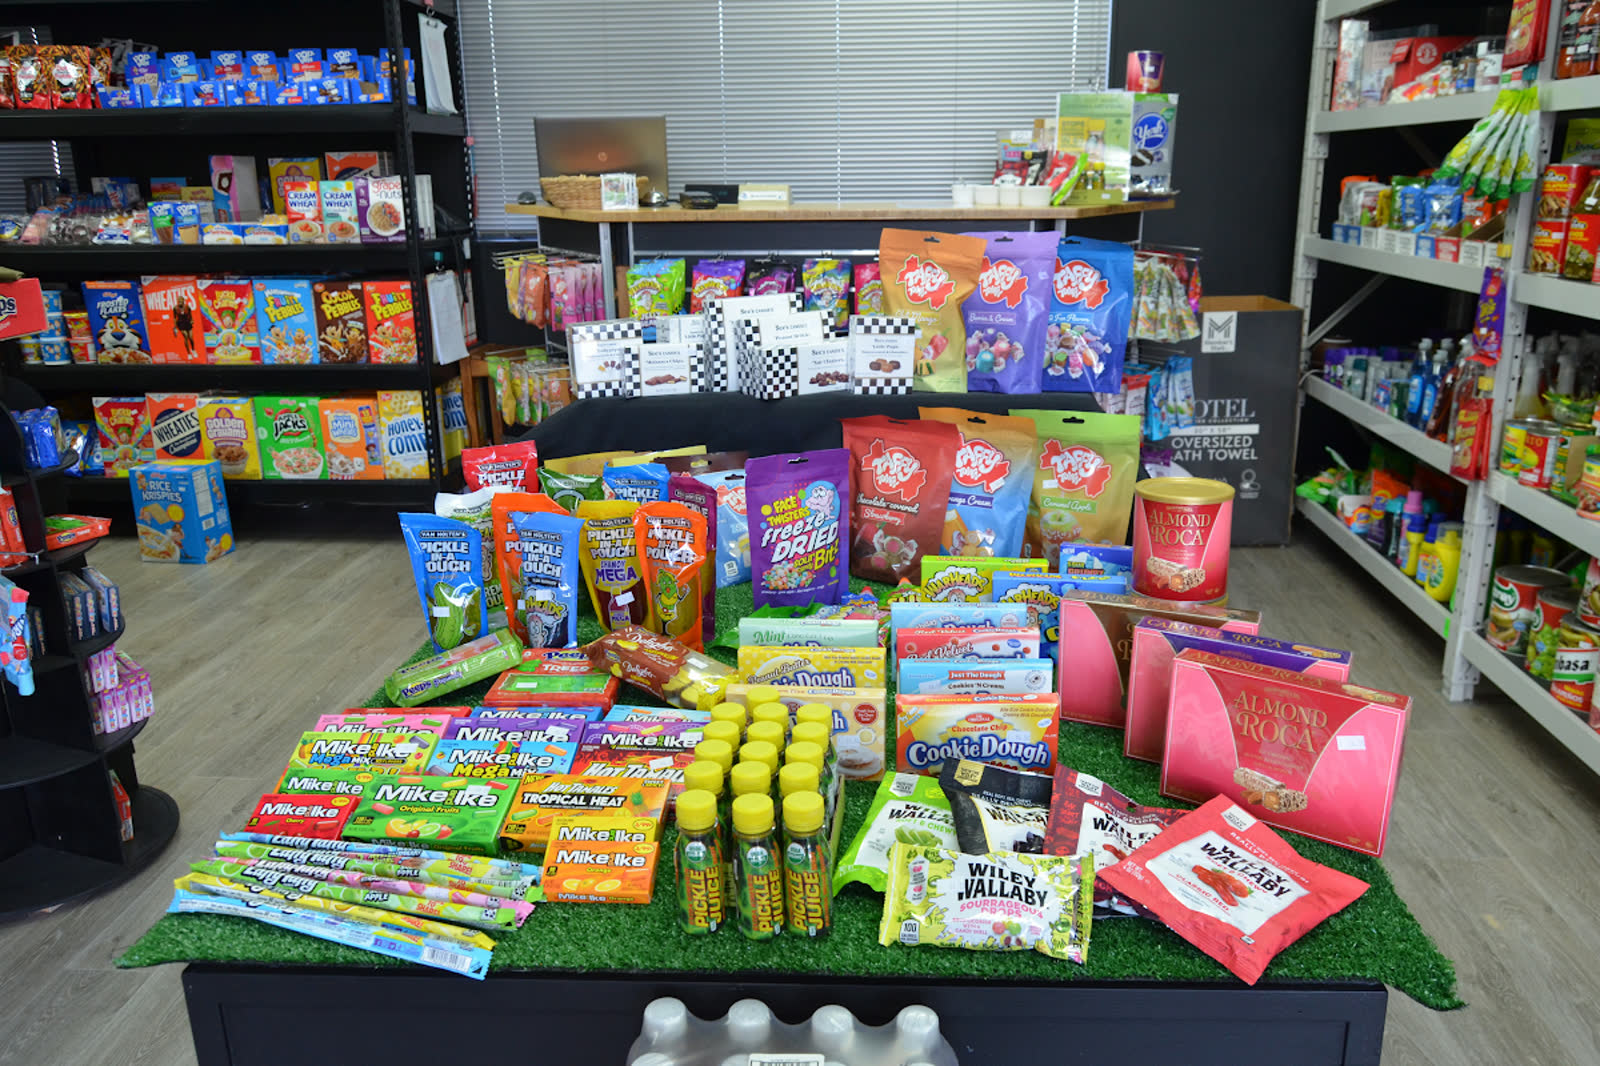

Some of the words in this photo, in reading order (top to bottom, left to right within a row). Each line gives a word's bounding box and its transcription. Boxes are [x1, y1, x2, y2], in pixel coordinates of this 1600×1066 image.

[288, 191, 316, 200] CREAM
[324, 191, 352, 200] CREAM
[289, 200, 316, 209] WHEAT
[324, 200, 352, 209] WHEAT
[904, 265, 948, 291] TAFFY
[979, 264, 1019, 291] TAFFY
[1054, 265, 1097, 291] TAFFY
[145, 286, 197, 311] WHEATIES
[321, 299, 361, 320] PEBBLES
[371, 299, 412, 320] PEBBLES
[1194, 399, 1256, 418] OTEL
[153, 411, 200, 443] WHEATIES
[274, 418, 308, 438] JACKS
[1171, 435, 1253, 449] OVERSIZED
[955, 445, 1001, 474] TAFFY
[1173, 449, 1201, 460] ATH
[1208, 449, 1258, 460] TOWEL
[872, 452, 919, 482] TAFFY
[1050, 449, 1101, 478] TAFFY
[477, 469, 525, 485] PICKLE
[149, 481, 172, 492] RICE
[614, 487, 660, 500] PICKLE
[142, 491, 183, 503] KRISPIES
[772, 496, 798, 514] FACE
[766, 506, 811, 527] TWISTERS
[1150, 509, 1211, 528] ALMOND
[587, 527, 635, 542] PICKLE
[648, 527, 695, 543] PICKLE
[761, 512, 825, 548] freeze
[1151, 525, 1205, 547] ROCA
[420, 541, 469, 553] PICKLE
[771, 521, 840, 563] DRIED
[590, 545, 636, 559] POUCH
[425, 561, 471, 572] OUCH
[595, 567, 637, 584] MEGA
[922, 571, 987, 598] WARHEADS
[753, 631, 785, 643] Mint
[1232, 634, 1282, 649] ROCA
[934, 642, 974, 657] Velvet
[780, 658, 811, 675] Butter
[1195, 651, 1264, 672] ALMOND
[1233, 690, 1328, 728] ALMOND
[455, 727, 523, 742] Mike
[530, 730, 569, 743] Ike
[951, 725, 989, 733] Chocolate
[1236, 711, 1318, 754] ROCA
[600, 733, 658, 745] Mike
[663, 735, 699, 747] Ike
[311, 740, 372, 755] Mike
[375, 743, 411, 758] Ike
[309, 753, 351, 766] Mega
[449, 749, 511, 764] Mike
[516, 752, 553, 767] Ike
[452, 763, 511, 779] Mega
[287, 777, 332, 791] Mike
[335, 780, 364, 794] Ike
[374, 784, 448, 802] Mike
[455, 789, 500, 807] Ike
[521, 793, 588, 806] TROPICAL
[589, 795, 626, 807] HEAT
[260, 802, 305, 816] Mike
[310, 805, 340, 818] Ike
[400, 805, 435, 813] Original
[270, 835, 311, 850] Laffy
[558, 826, 609, 841] Mike
[614, 829, 646, 842] Ike
[555, 850, 609, 864] Mike
[613, 852, 647, 867] Ike
[1221, 844, 1288, 885] WILEY
[396, 868, 421, 878] APPLE
[967, 862, 1036, 888] WILEY
[1200, 842, 1291, 898] WALLABY
[364, 892, 390, 902] APPLE
[689, 870, 709, 928] PICKLE
[706, 866, 722, 924] JUICE
[752, 874, 773, 932] PICKLE
[769, 869, 785, 926] JUICE
[789, 870, 808, 931] PICKLE
[802, 871, 824, 930] JUICE
[416, 903, 441, 915] SHARE!
[1211, 897, 1231, 912] RED
[904, 922, 917, 933] 100
